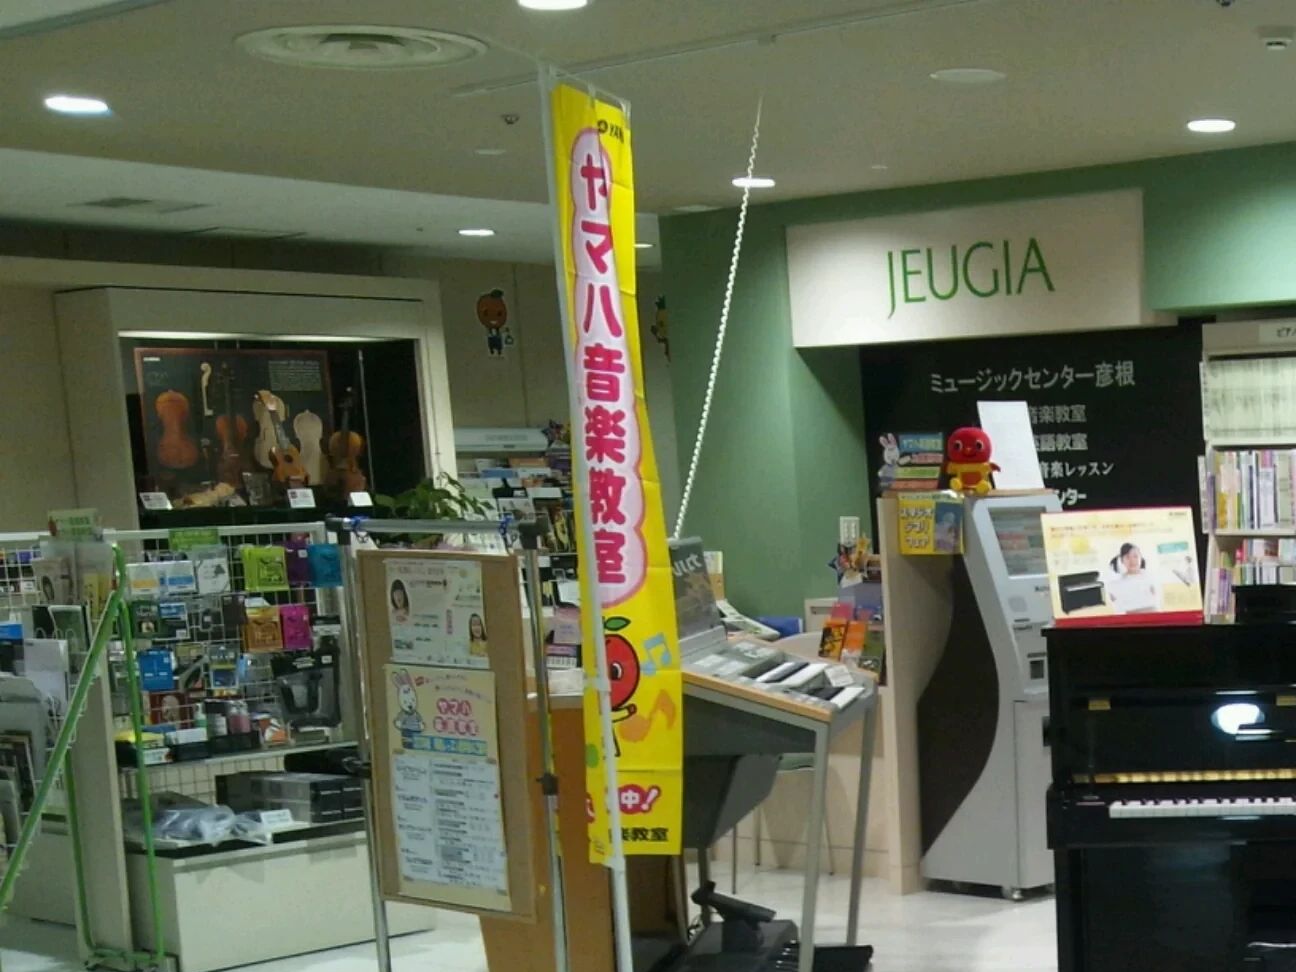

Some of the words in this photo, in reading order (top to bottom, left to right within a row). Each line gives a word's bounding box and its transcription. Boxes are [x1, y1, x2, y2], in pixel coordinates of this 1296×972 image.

[886, 238, 1056, 319] JEUGIA
[579, 153, 628, 585] ヤマハ音楽教室
[929, 360, 1137, 394] ミュージックセンター彦根
